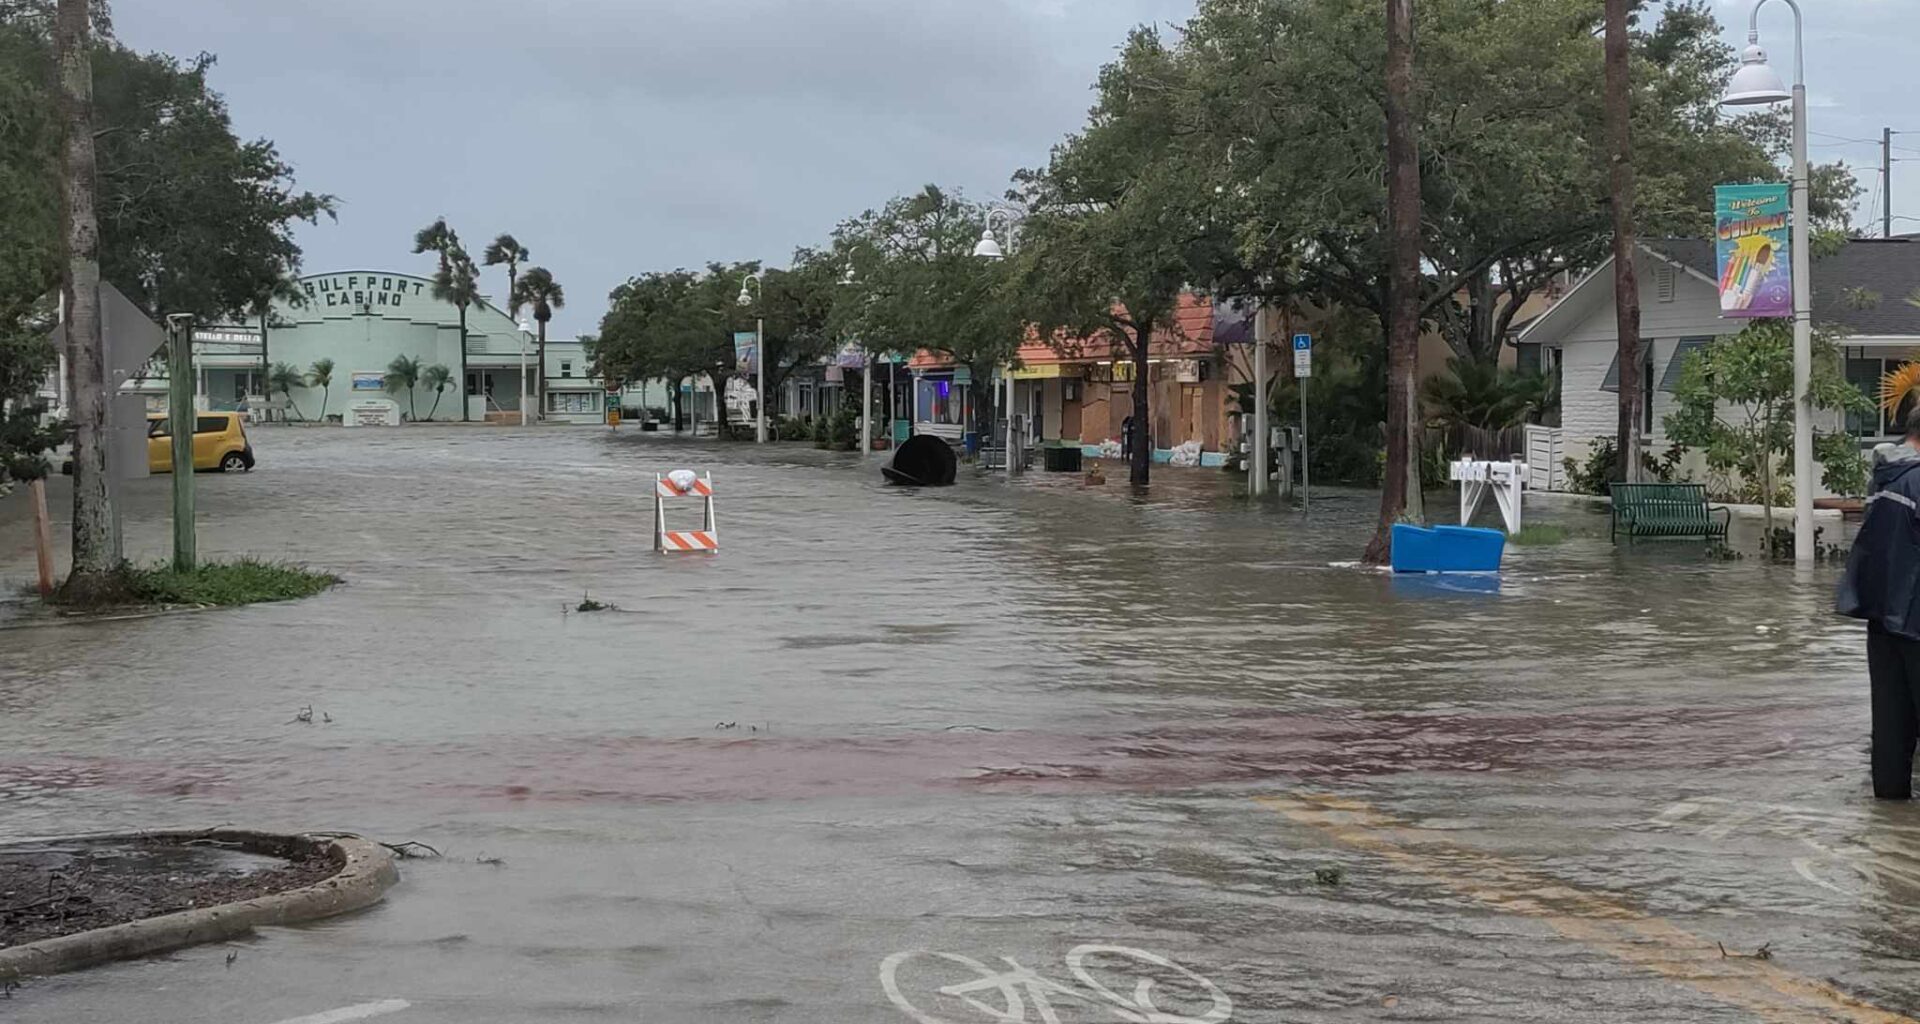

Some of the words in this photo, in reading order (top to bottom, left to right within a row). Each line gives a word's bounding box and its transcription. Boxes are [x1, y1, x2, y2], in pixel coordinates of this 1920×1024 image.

[1728, 195, 1778, 211] Welcome
[303, 276, 424, 296] GULFPORT
[326, 290, 402, 307] CASINO
